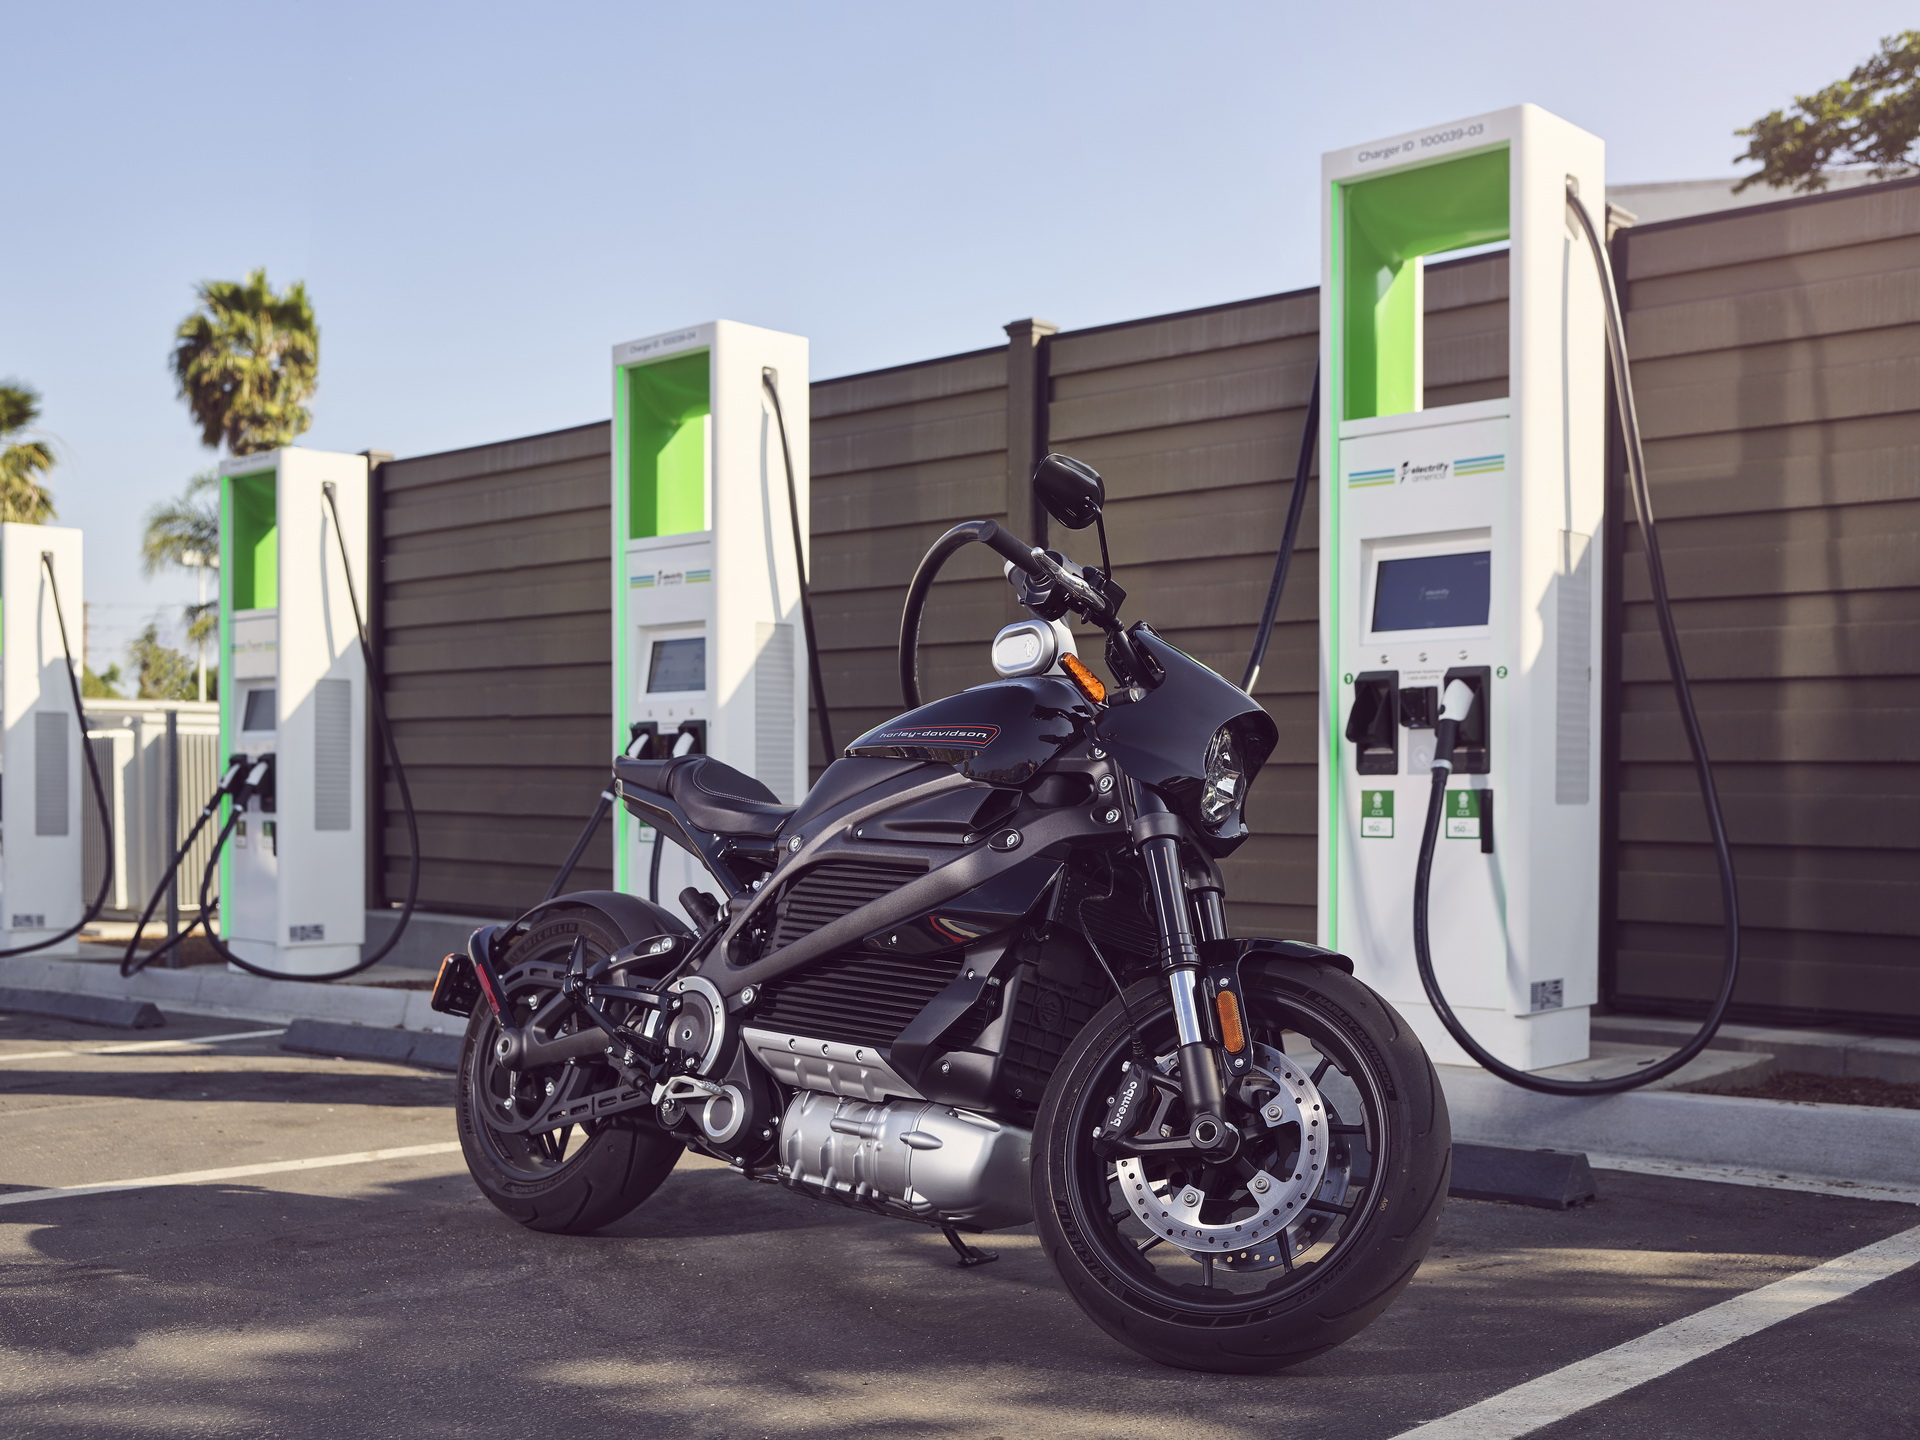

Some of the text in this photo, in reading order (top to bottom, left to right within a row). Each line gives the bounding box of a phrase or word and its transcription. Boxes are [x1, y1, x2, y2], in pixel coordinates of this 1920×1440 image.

[1357, 123, 1484, 163] Charger ID 100039-03
[1411, 462, 1449, 474] electrify
[1411, 473, 1446, 483] america
[1371, 808, 1384, 817] CCS
[1456, 808, 1470, 817] CCS
[1453, 825, 1466, 833] 150
[522, 923, 577, 952] MICHELIN
[1313, 995, 1395, 1094] HARLEY-DAVIDSON
[1110, 1081, 1138, 1127] brembo
[1057, 1204, 1107, 1280] MICHELIN
